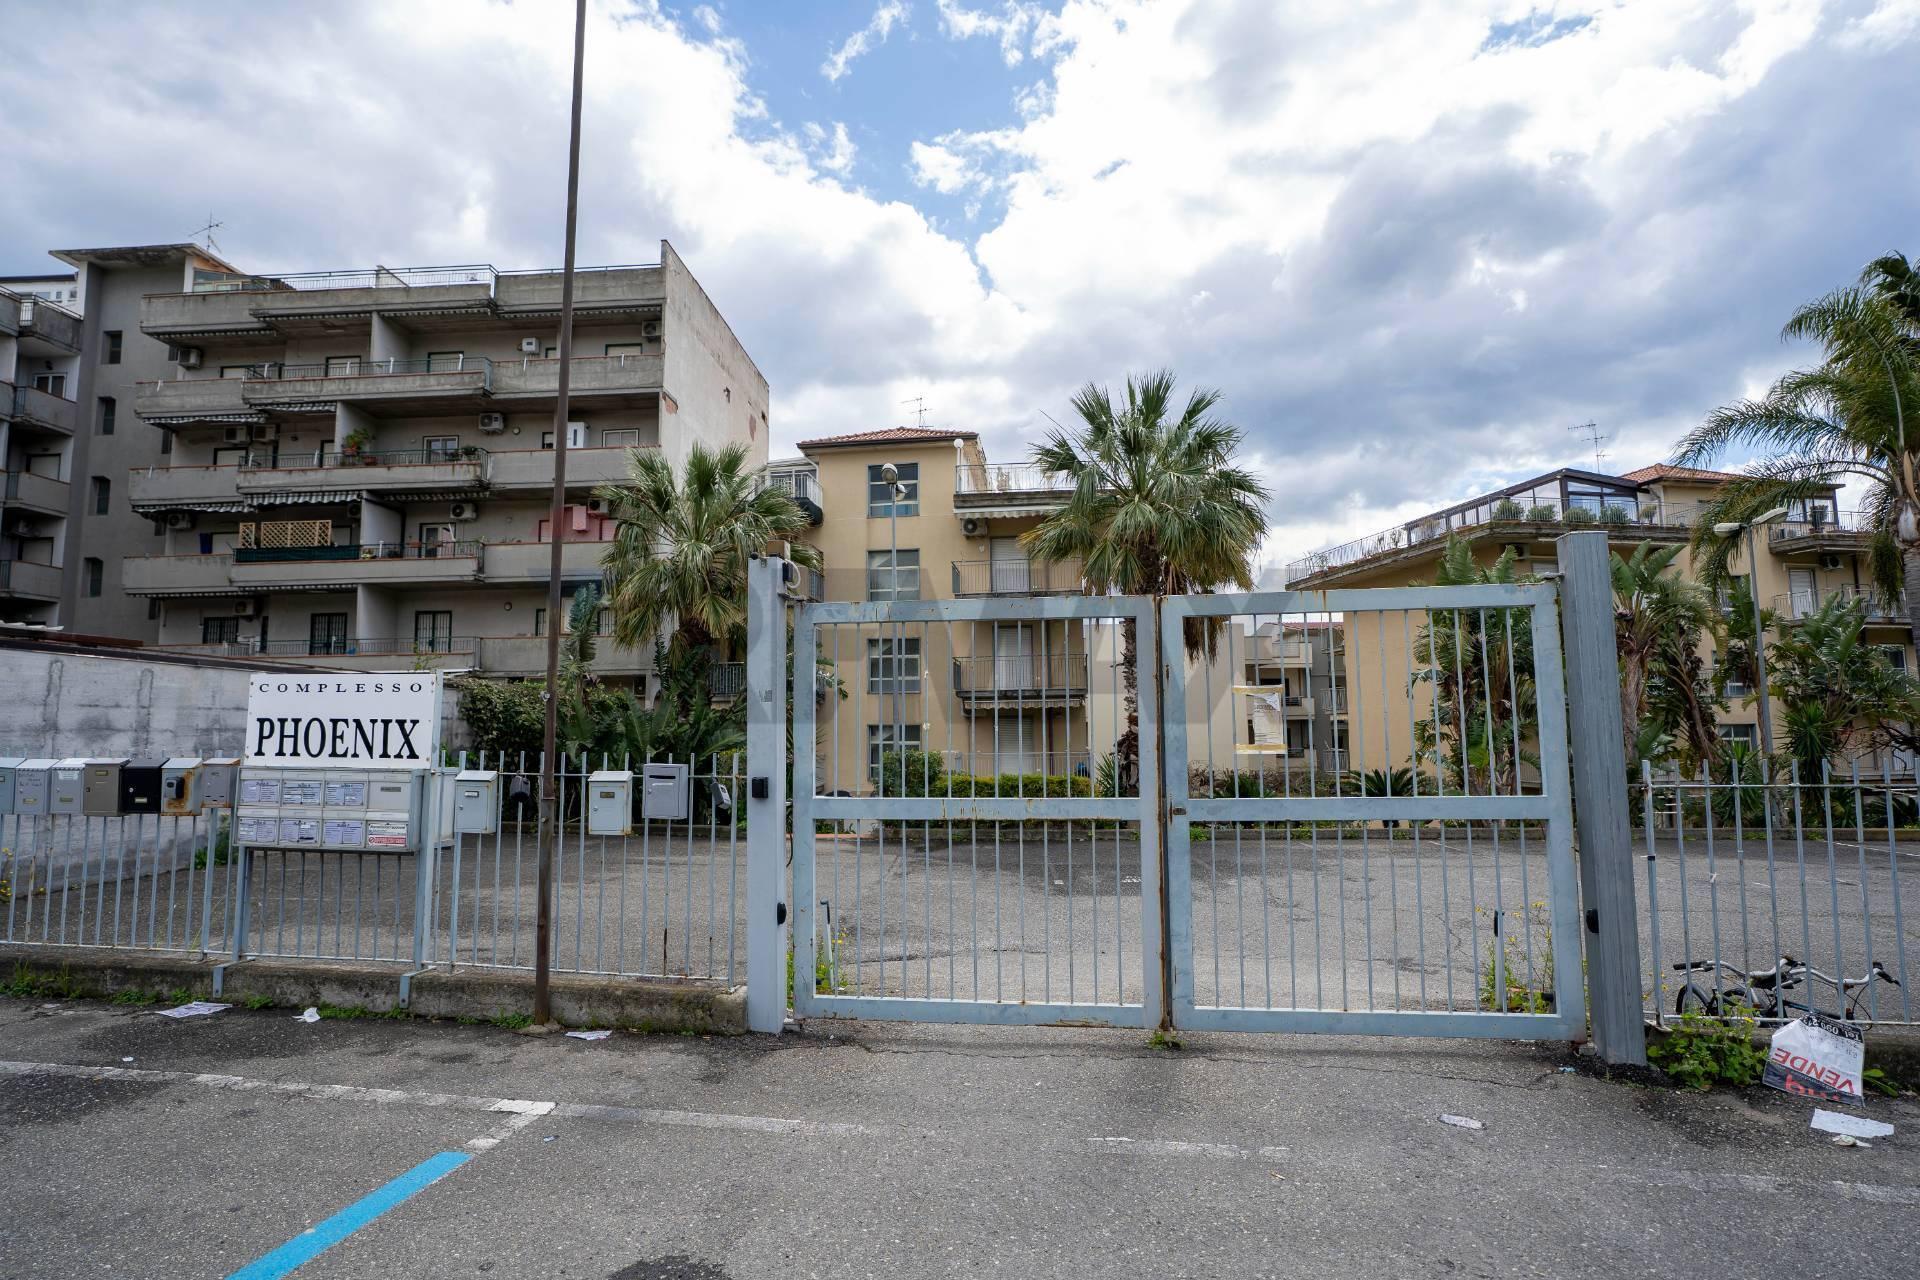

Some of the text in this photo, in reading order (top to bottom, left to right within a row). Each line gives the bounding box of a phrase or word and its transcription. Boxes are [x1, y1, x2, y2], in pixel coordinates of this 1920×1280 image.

[259, 683, 422, 693] COMPLESSO
[254, 717, 420, 759] PHOENIX
[1771, 1047, 1855, 1094] VENDE
